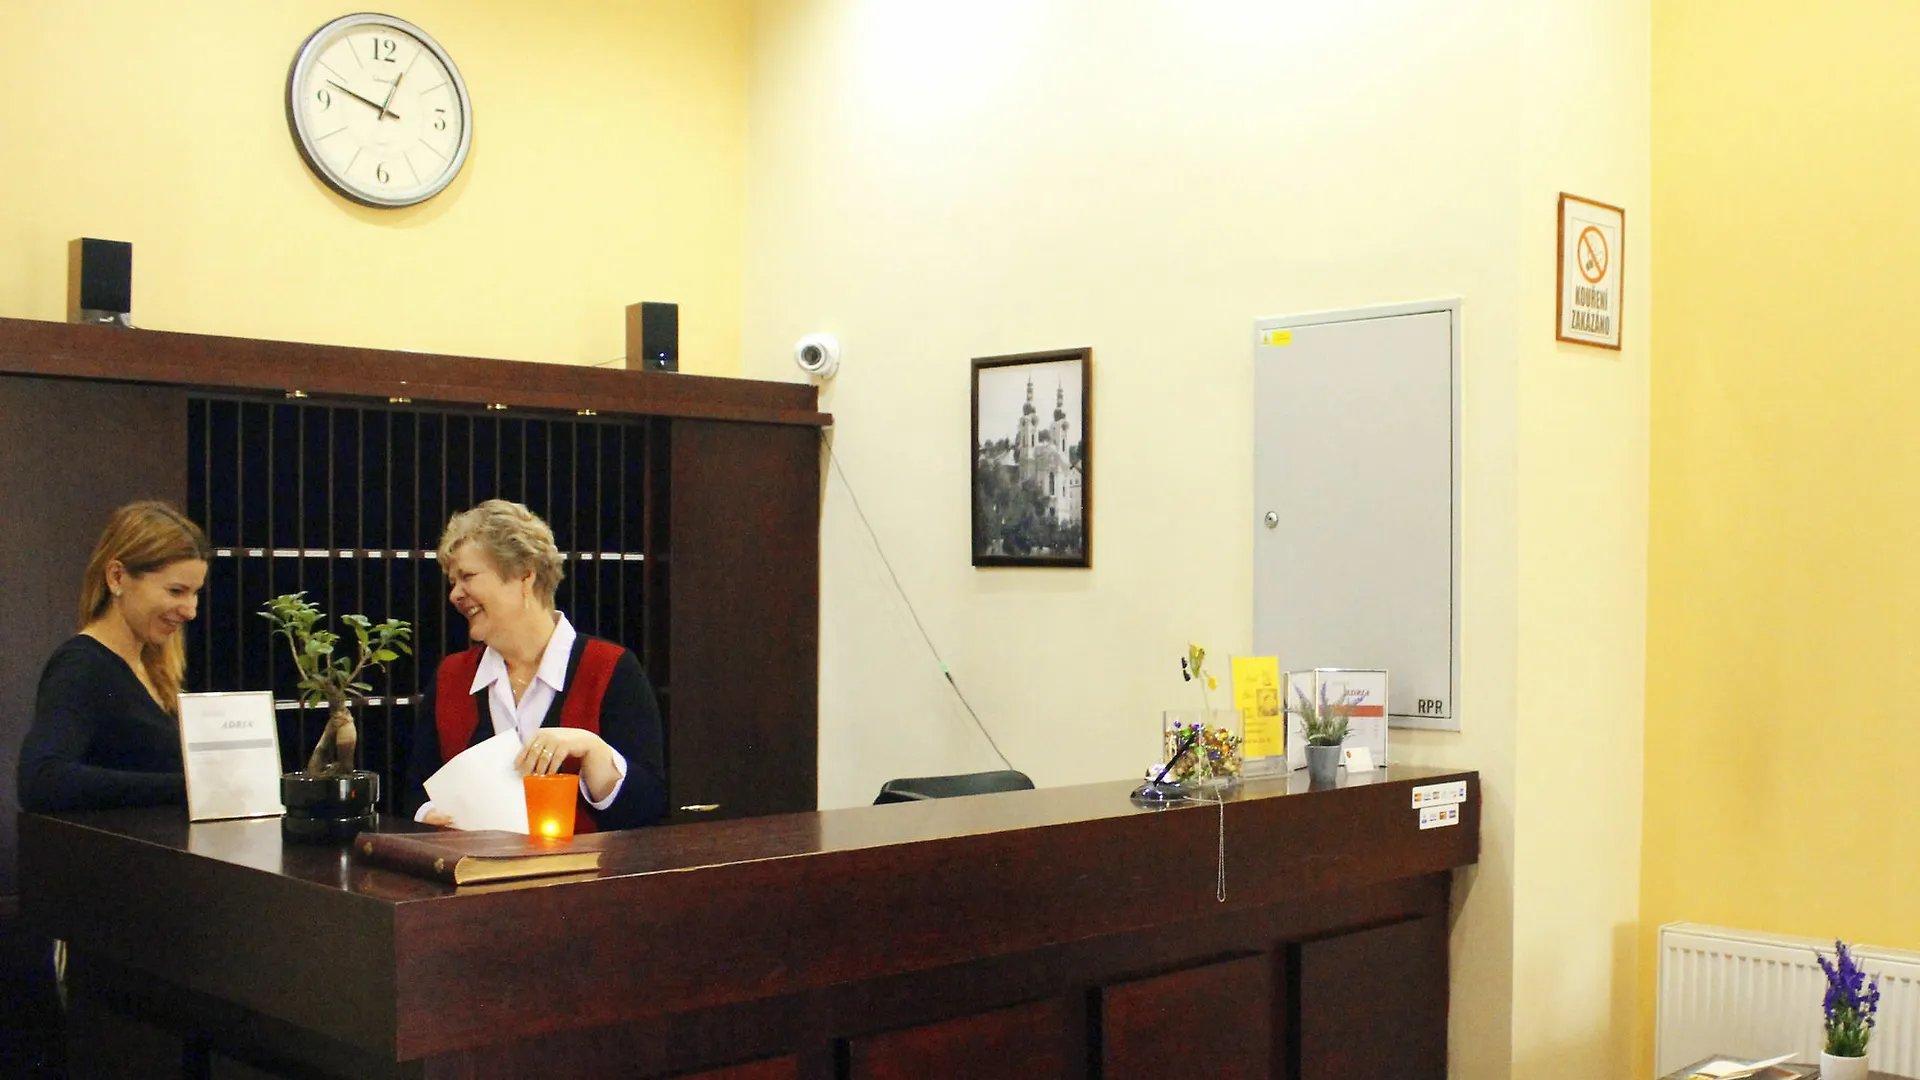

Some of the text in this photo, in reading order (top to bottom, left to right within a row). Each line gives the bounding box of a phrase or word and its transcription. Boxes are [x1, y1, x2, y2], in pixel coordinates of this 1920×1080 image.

[372, 37, 397, 63] 12
[316, 88, 332, 112] 9
[433, 108, 447, 132] 3
[376, 163, 390, 184] 6
[1418, 699, 1443, 714] RPR
